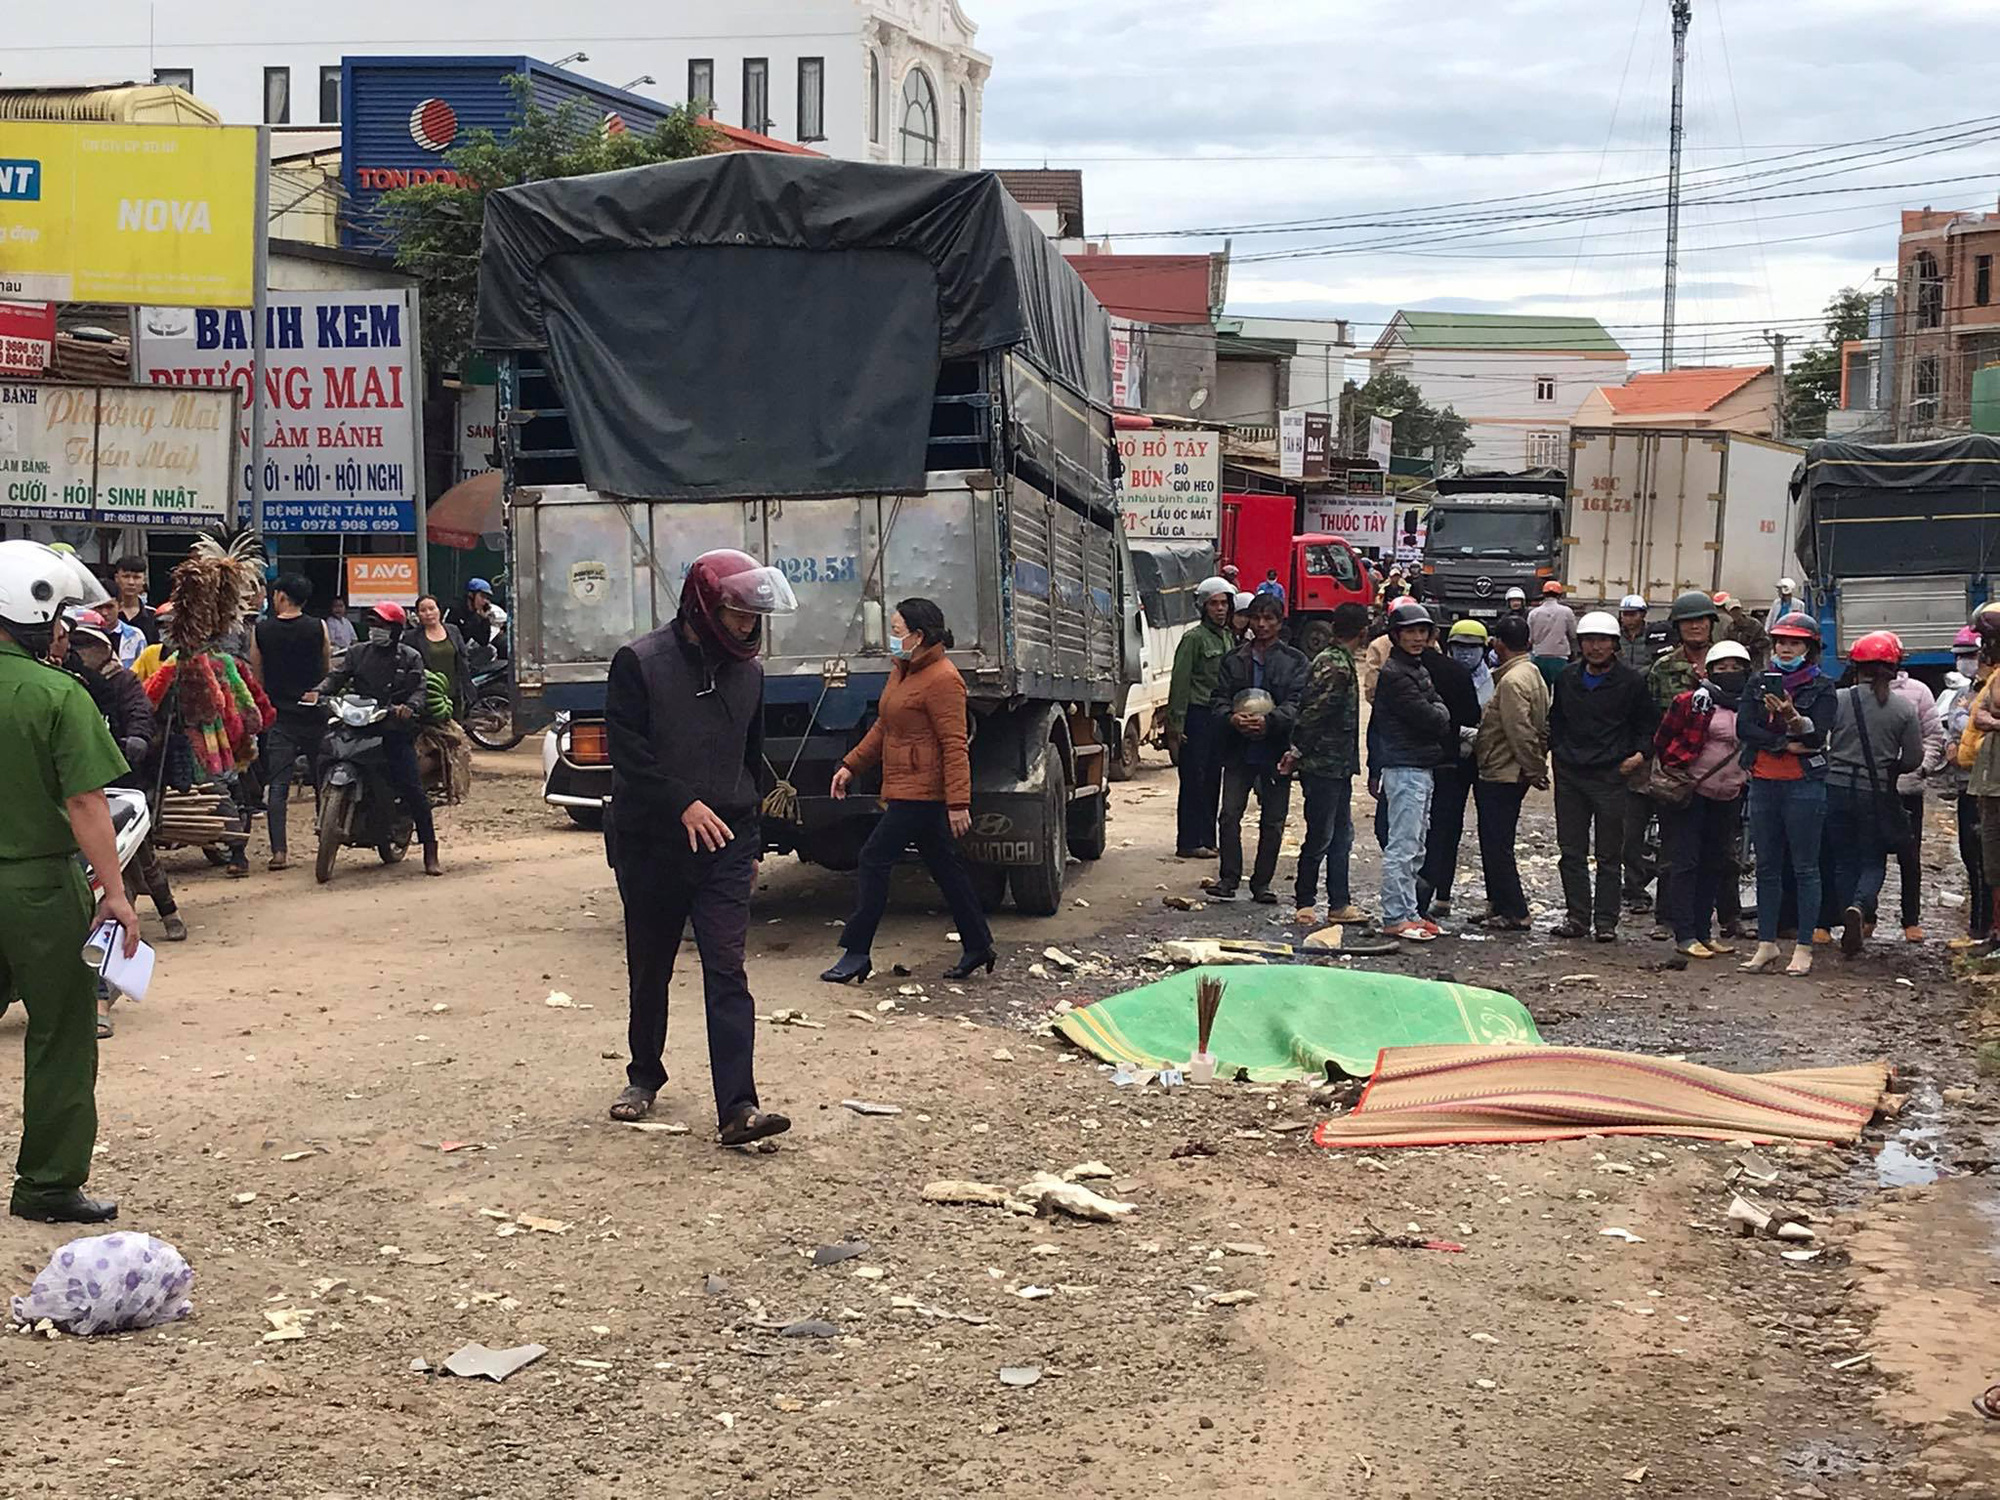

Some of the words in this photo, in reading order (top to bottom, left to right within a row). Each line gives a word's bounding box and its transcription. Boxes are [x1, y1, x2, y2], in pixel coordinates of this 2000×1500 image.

[117, 199, 212, 234] NOVA
[316, 304, 401, 348] KEM
[323, 365, 404, 409] MAI
[317, 420, 384, 448] BÁNH
[1173, 437, 1208, 458] TÂY
[294, 453, 320, 491] HỎI
[336, 457, 362, 497] HỘI
[1131, 466, 1163, 488] BÚN
[1194, 480, 1214, 492] HEO
[8, 478, 47, 502] CƯỚI
[63, 478, 92, 504] HỎI
[107, 487, 146, 507] SINH
[152, 486, 198, 511] NHẬT
[266, 503, 304, 518] BỆNH
[308, 503, 342, 518] VIỆN
[345, 503, 374, 517] TÂN
[378, 502, 398, 517] HÀ
[1320, 508, 1360, 531] THUỐC
[1363, 510, 1387, 532] TÂY
[301, 520, 337, 531] 0978
[372, 520, 399, 531] 699
[371, 563, 412, 579] AVG
